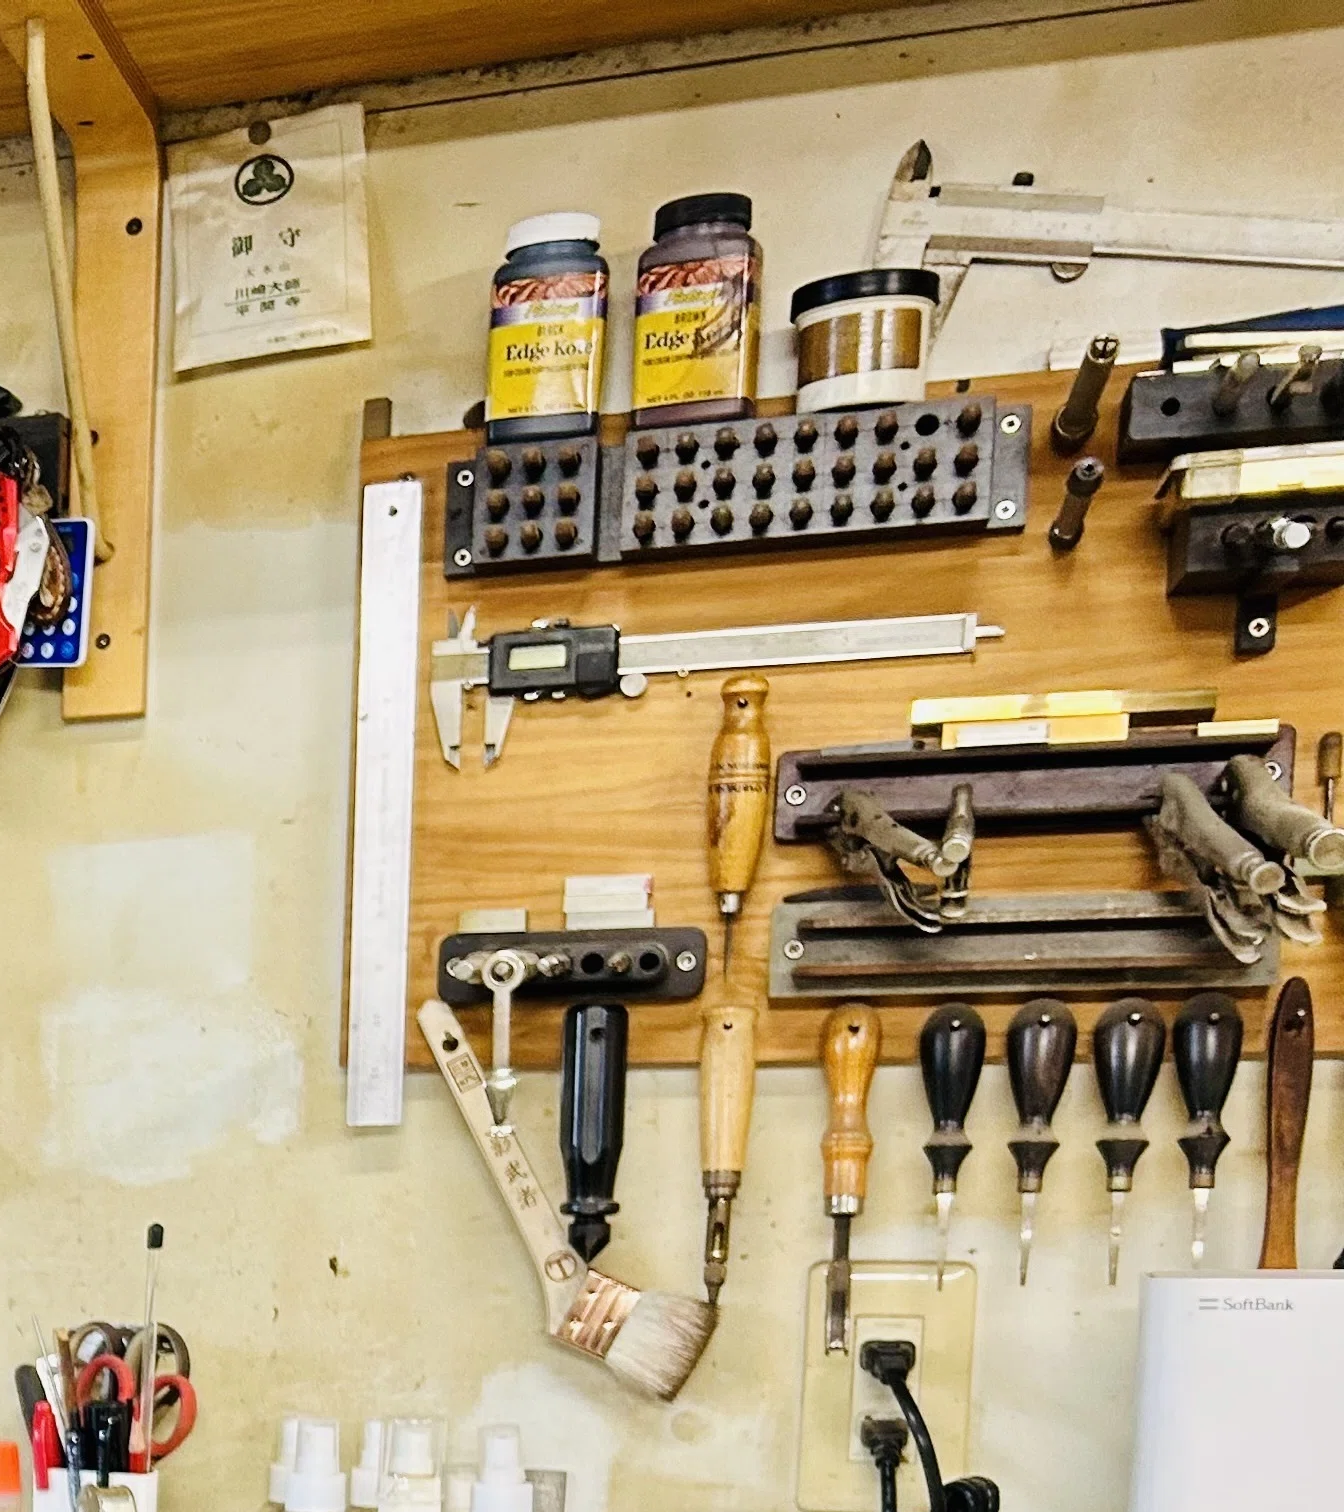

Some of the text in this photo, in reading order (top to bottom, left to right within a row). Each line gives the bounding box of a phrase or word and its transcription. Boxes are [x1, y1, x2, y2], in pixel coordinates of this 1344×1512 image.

[644, 330, 690, 350] Edge
[506, 342, 550, 363] Edge
[1223, 1297, 1294, 1311] SoftBank
